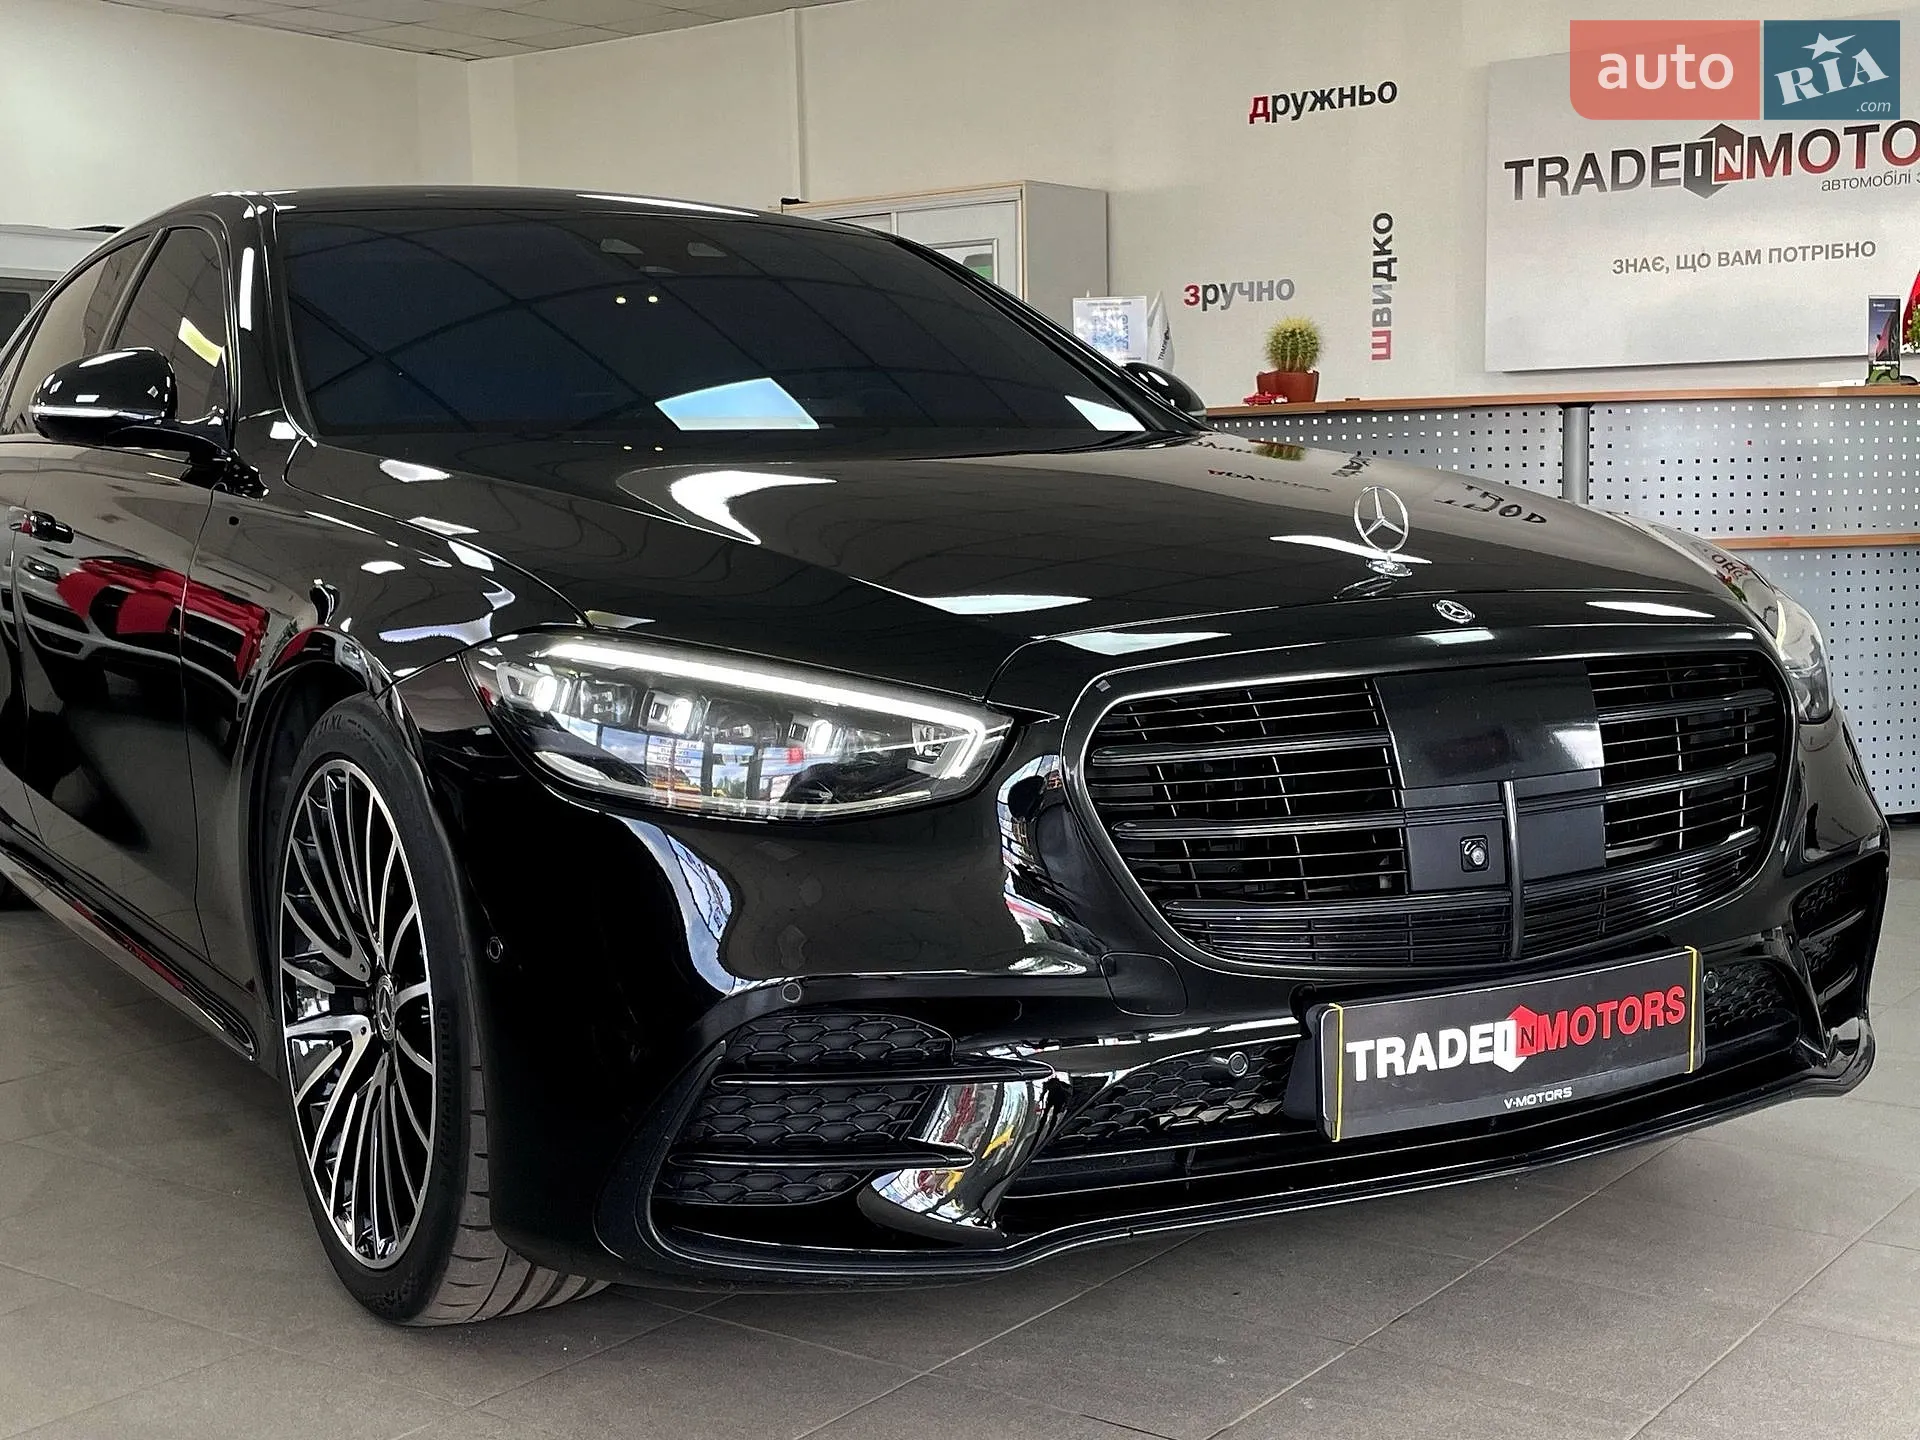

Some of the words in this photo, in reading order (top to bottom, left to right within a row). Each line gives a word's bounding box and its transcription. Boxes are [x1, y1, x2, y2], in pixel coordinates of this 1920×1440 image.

[1249, 80, 1398, 125] дружньо
[1821, 170, 1911, 192] автомобілі
[1612, 257, 1670, 275] ЗНАЄ,
[1675, 253, 1711, 275] ЩО
[1717, 249, 1762, 268] ВАМ
[1768, 240, 1877, 265] ПОТРІБНО
[1183, 277, 1295, 311] зручно
[1371, 212, 1398, 360] швидко
